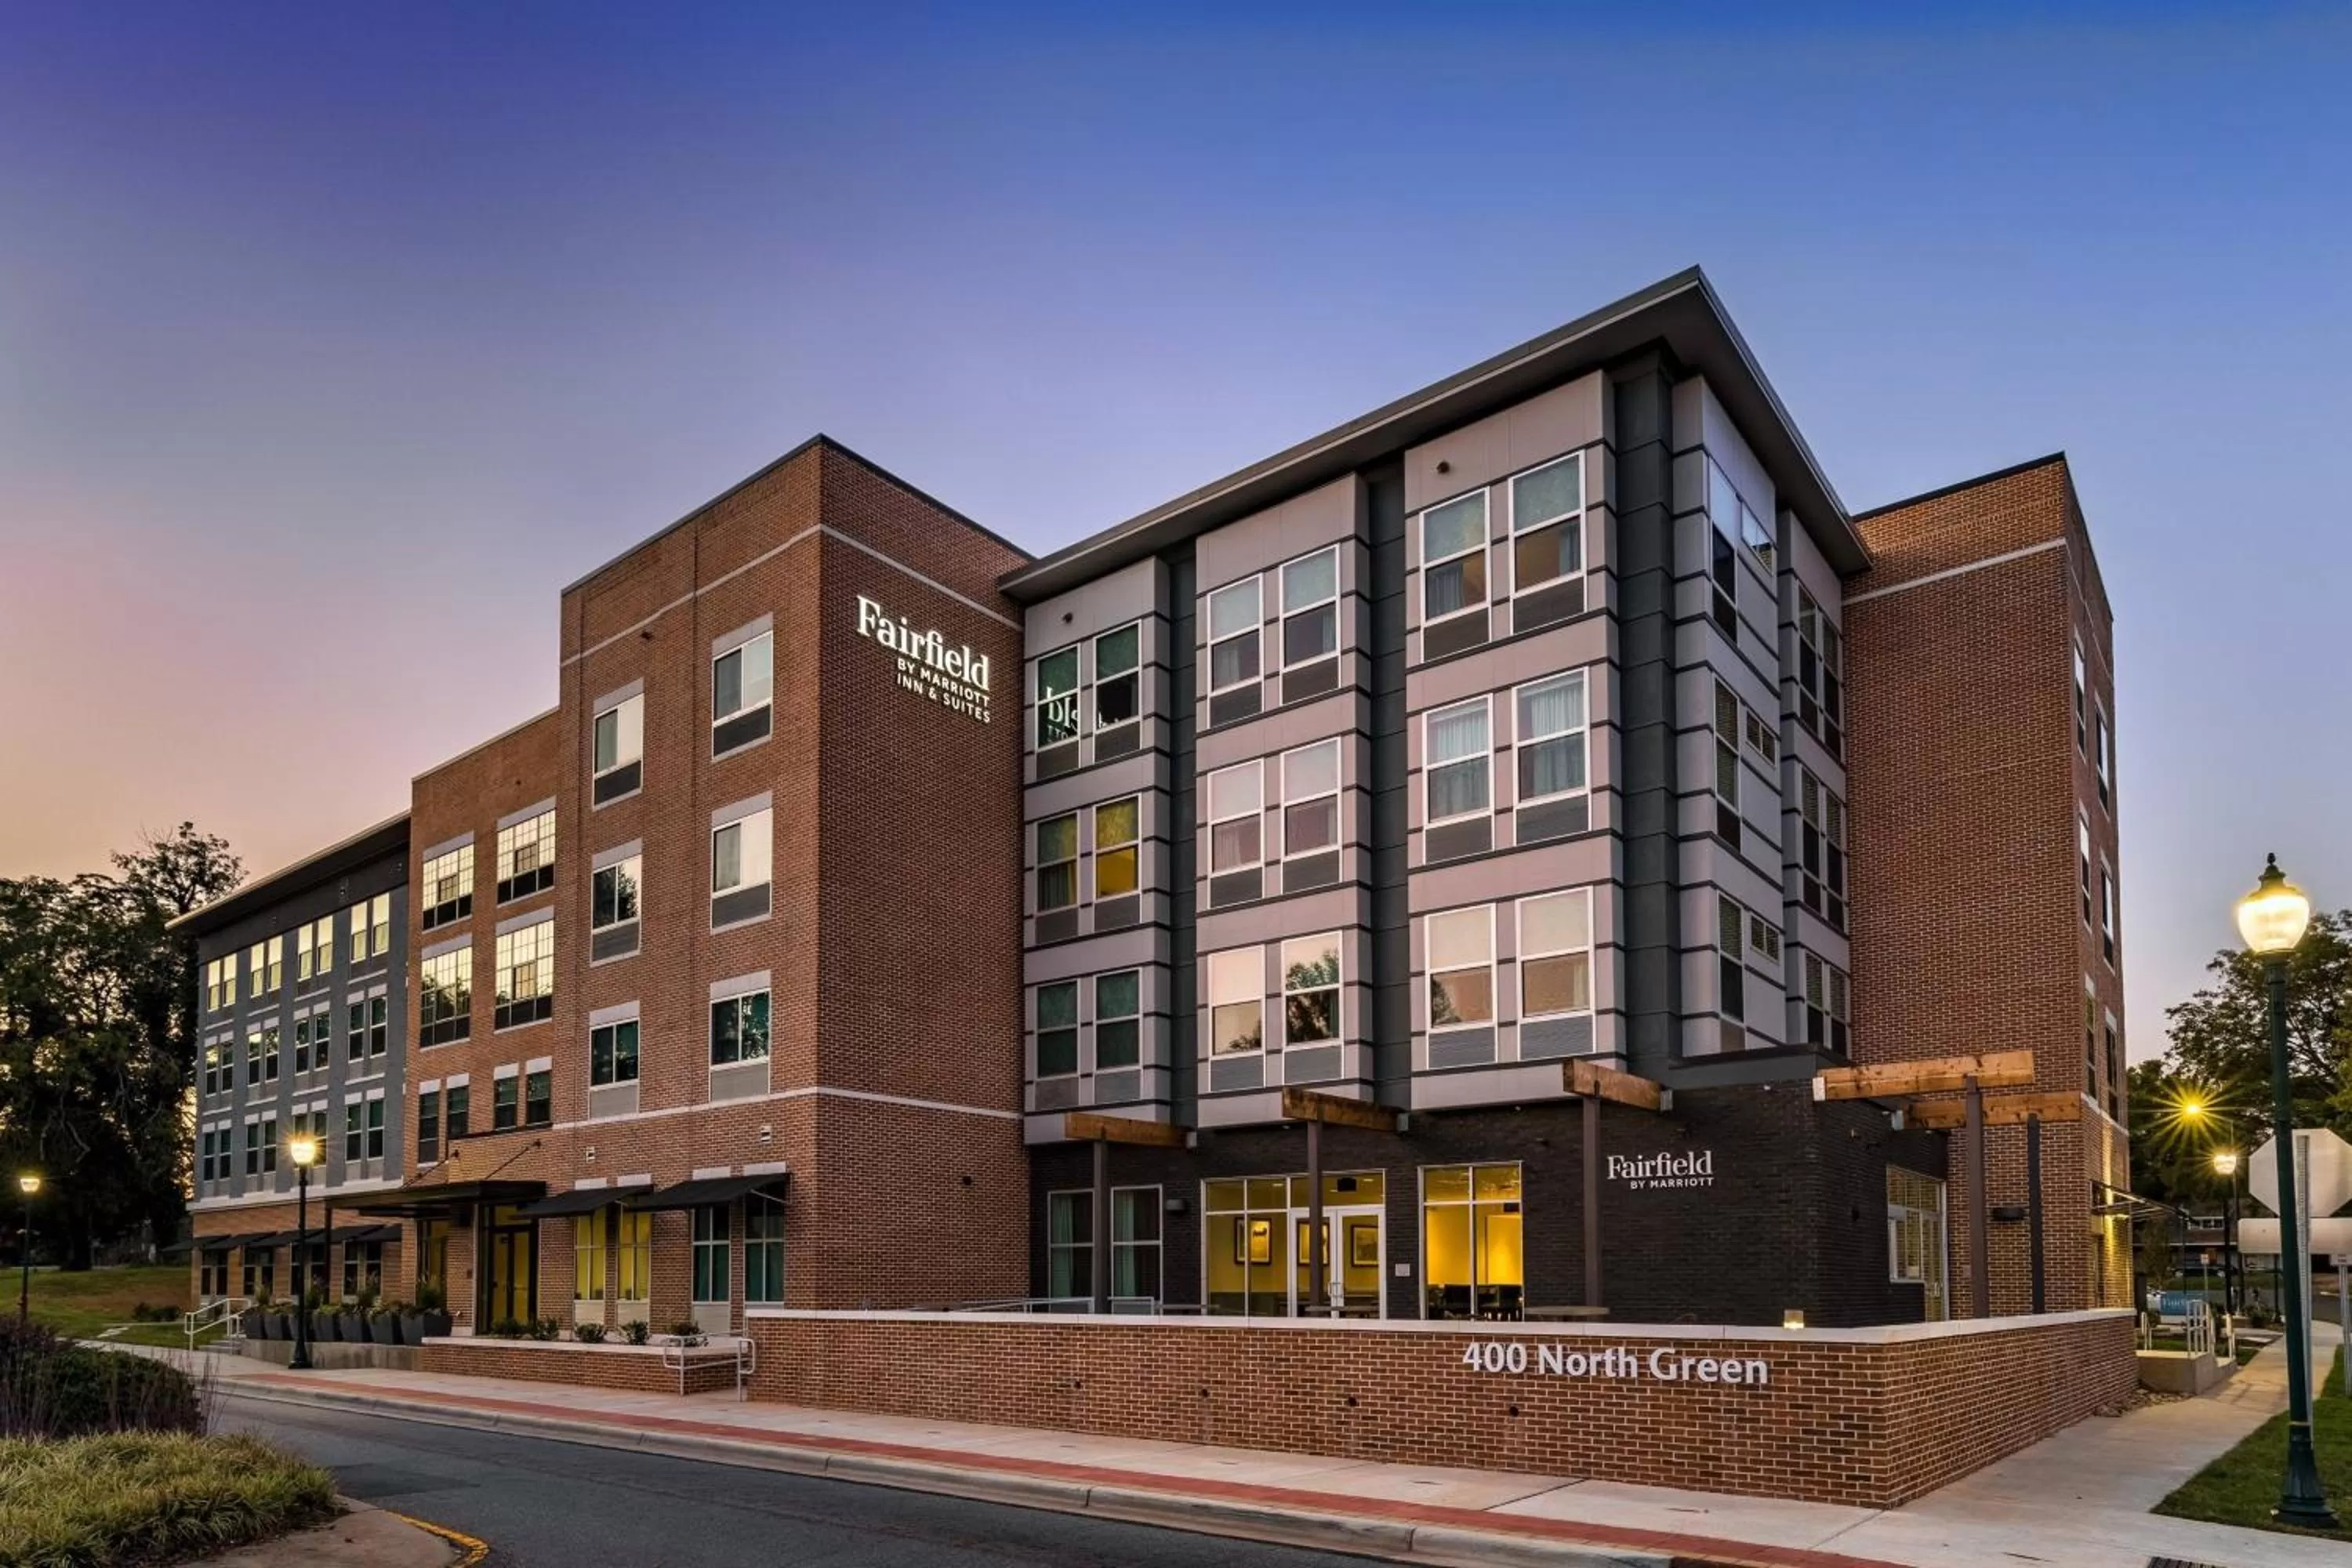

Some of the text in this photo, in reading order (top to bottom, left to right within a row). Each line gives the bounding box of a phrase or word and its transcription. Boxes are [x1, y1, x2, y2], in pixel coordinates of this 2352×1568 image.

[857, 594, 989, 691] Fairfield
[897, 673, 991, 724] INN & SUITES
[898, 659, 990, 707] BY MARRIOTT
[1607, 1150, 1713, 1179] Fairfield
[1631, 1177, 1714, 1189] BY MARRIOTT
[1463, 1341, 1768, 1384] 400 North Green
